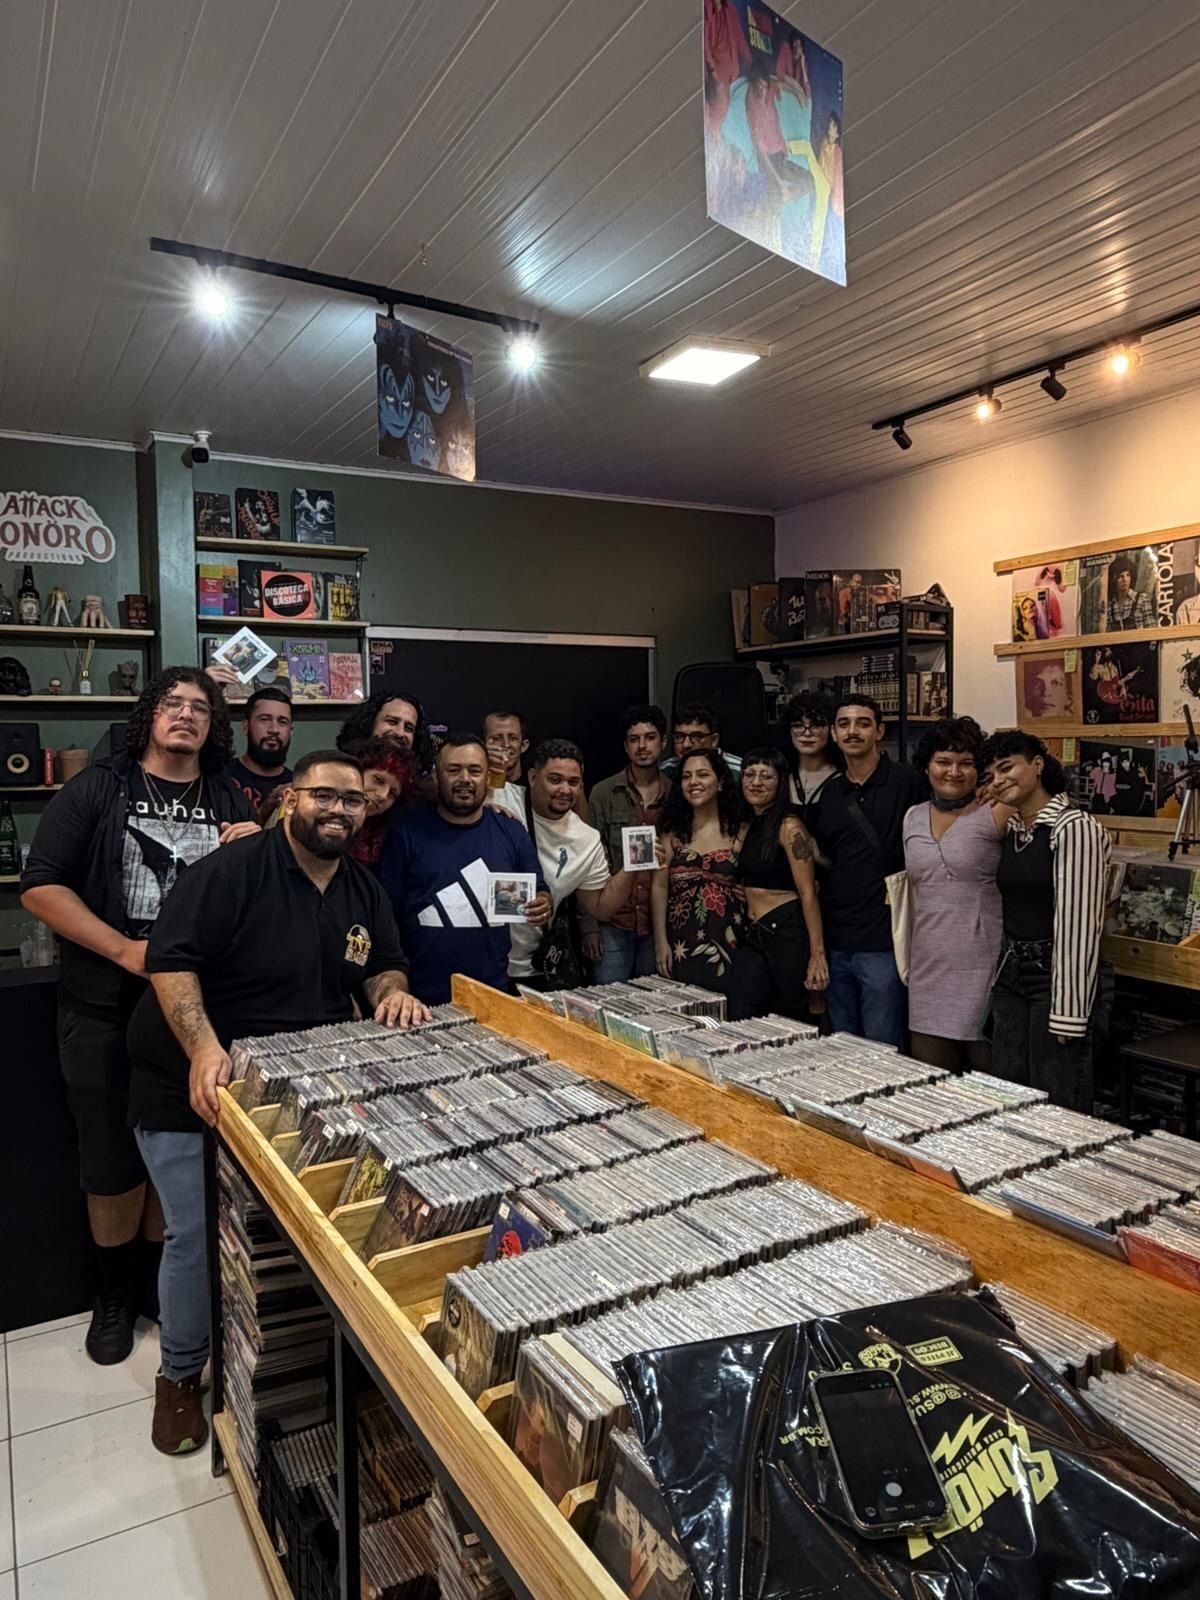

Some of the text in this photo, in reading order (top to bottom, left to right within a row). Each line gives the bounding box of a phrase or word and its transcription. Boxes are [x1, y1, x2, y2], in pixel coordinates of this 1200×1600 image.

[0, 494, 88, 523] ATTACK
[0, 520, 113, 560] ONÖRO
[264, 583, 309, 598] DISCOTECA
[1158, 543, 1173, 628] CARTOLA
[779, 1426, 823, 1446] COM.BR
